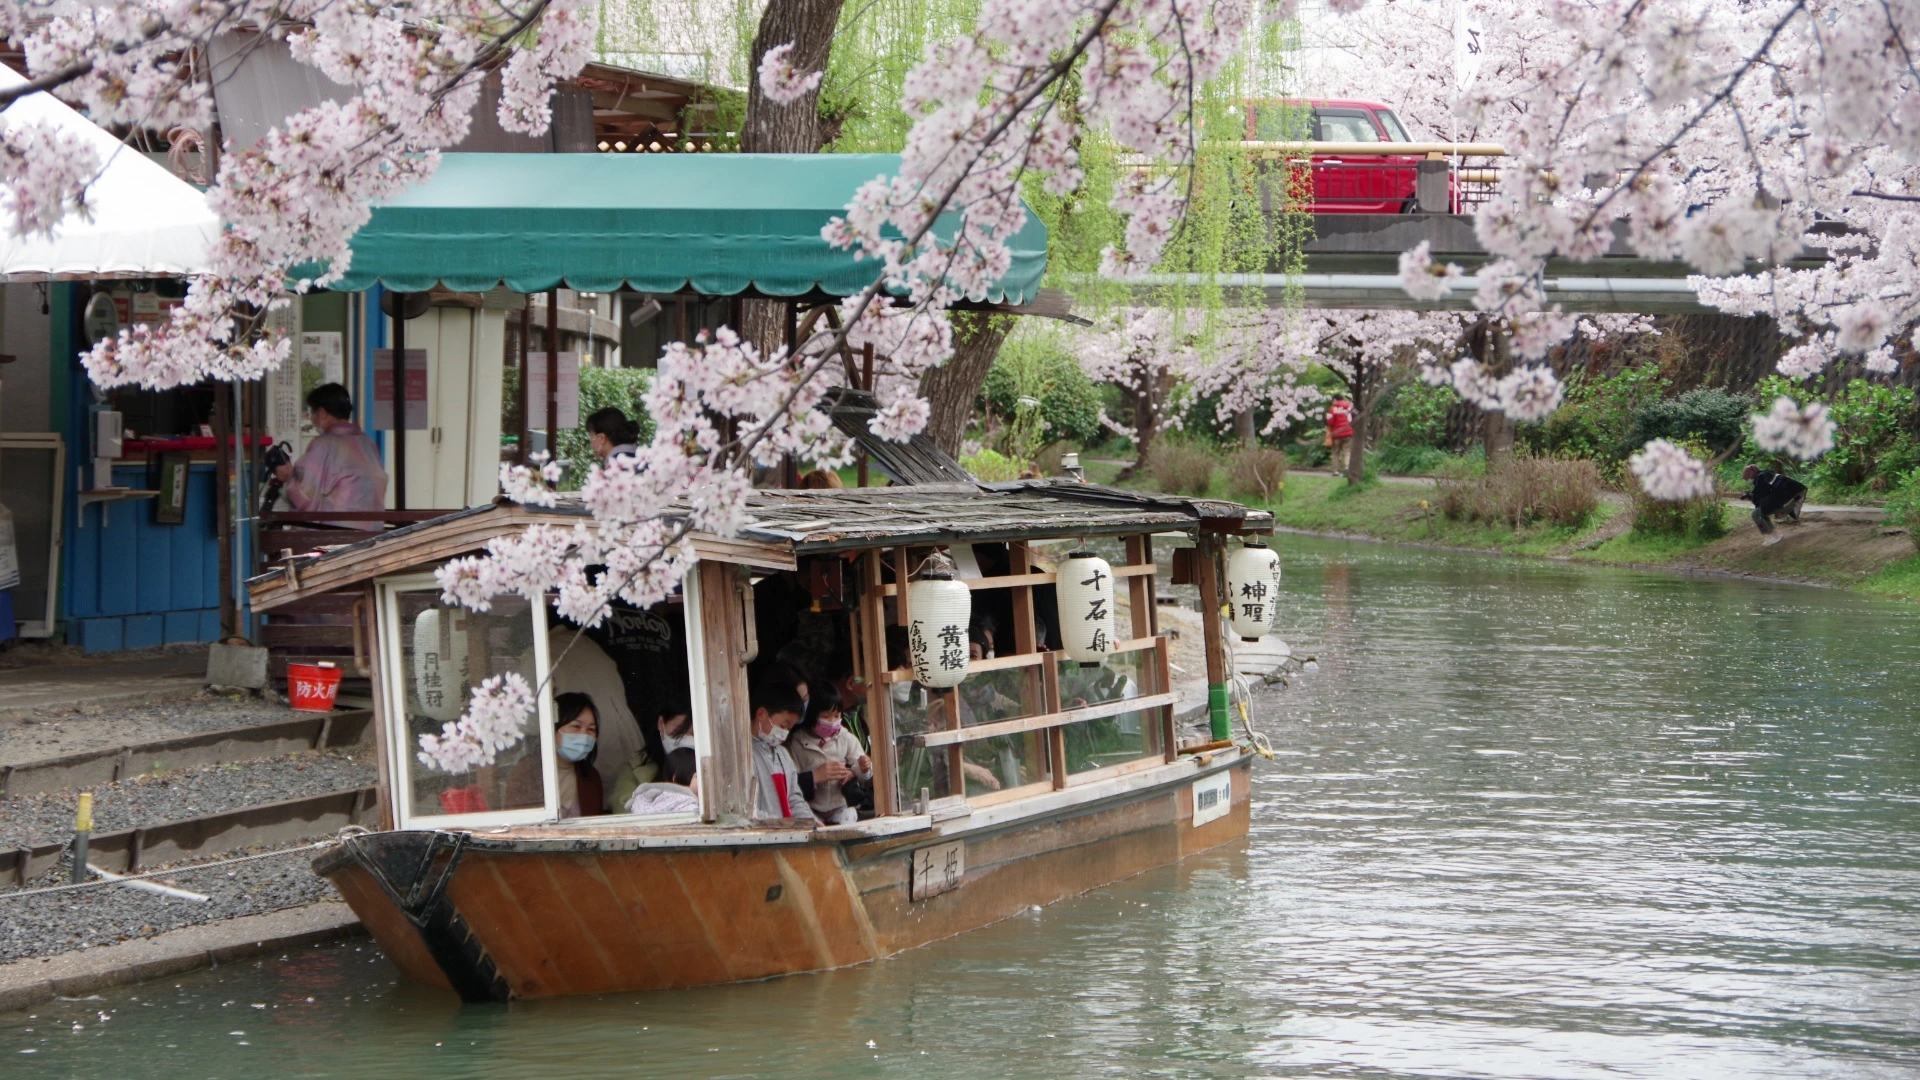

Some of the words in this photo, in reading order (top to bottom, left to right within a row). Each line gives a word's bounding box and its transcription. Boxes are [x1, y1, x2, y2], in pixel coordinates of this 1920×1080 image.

[1080, 569, 1110, 653] 十石舟
[1240, 580, 1267, 623] 神聖
[937, 624, 966, 671] 黄桜
[423, 652, 444, 707] 月桂冠
